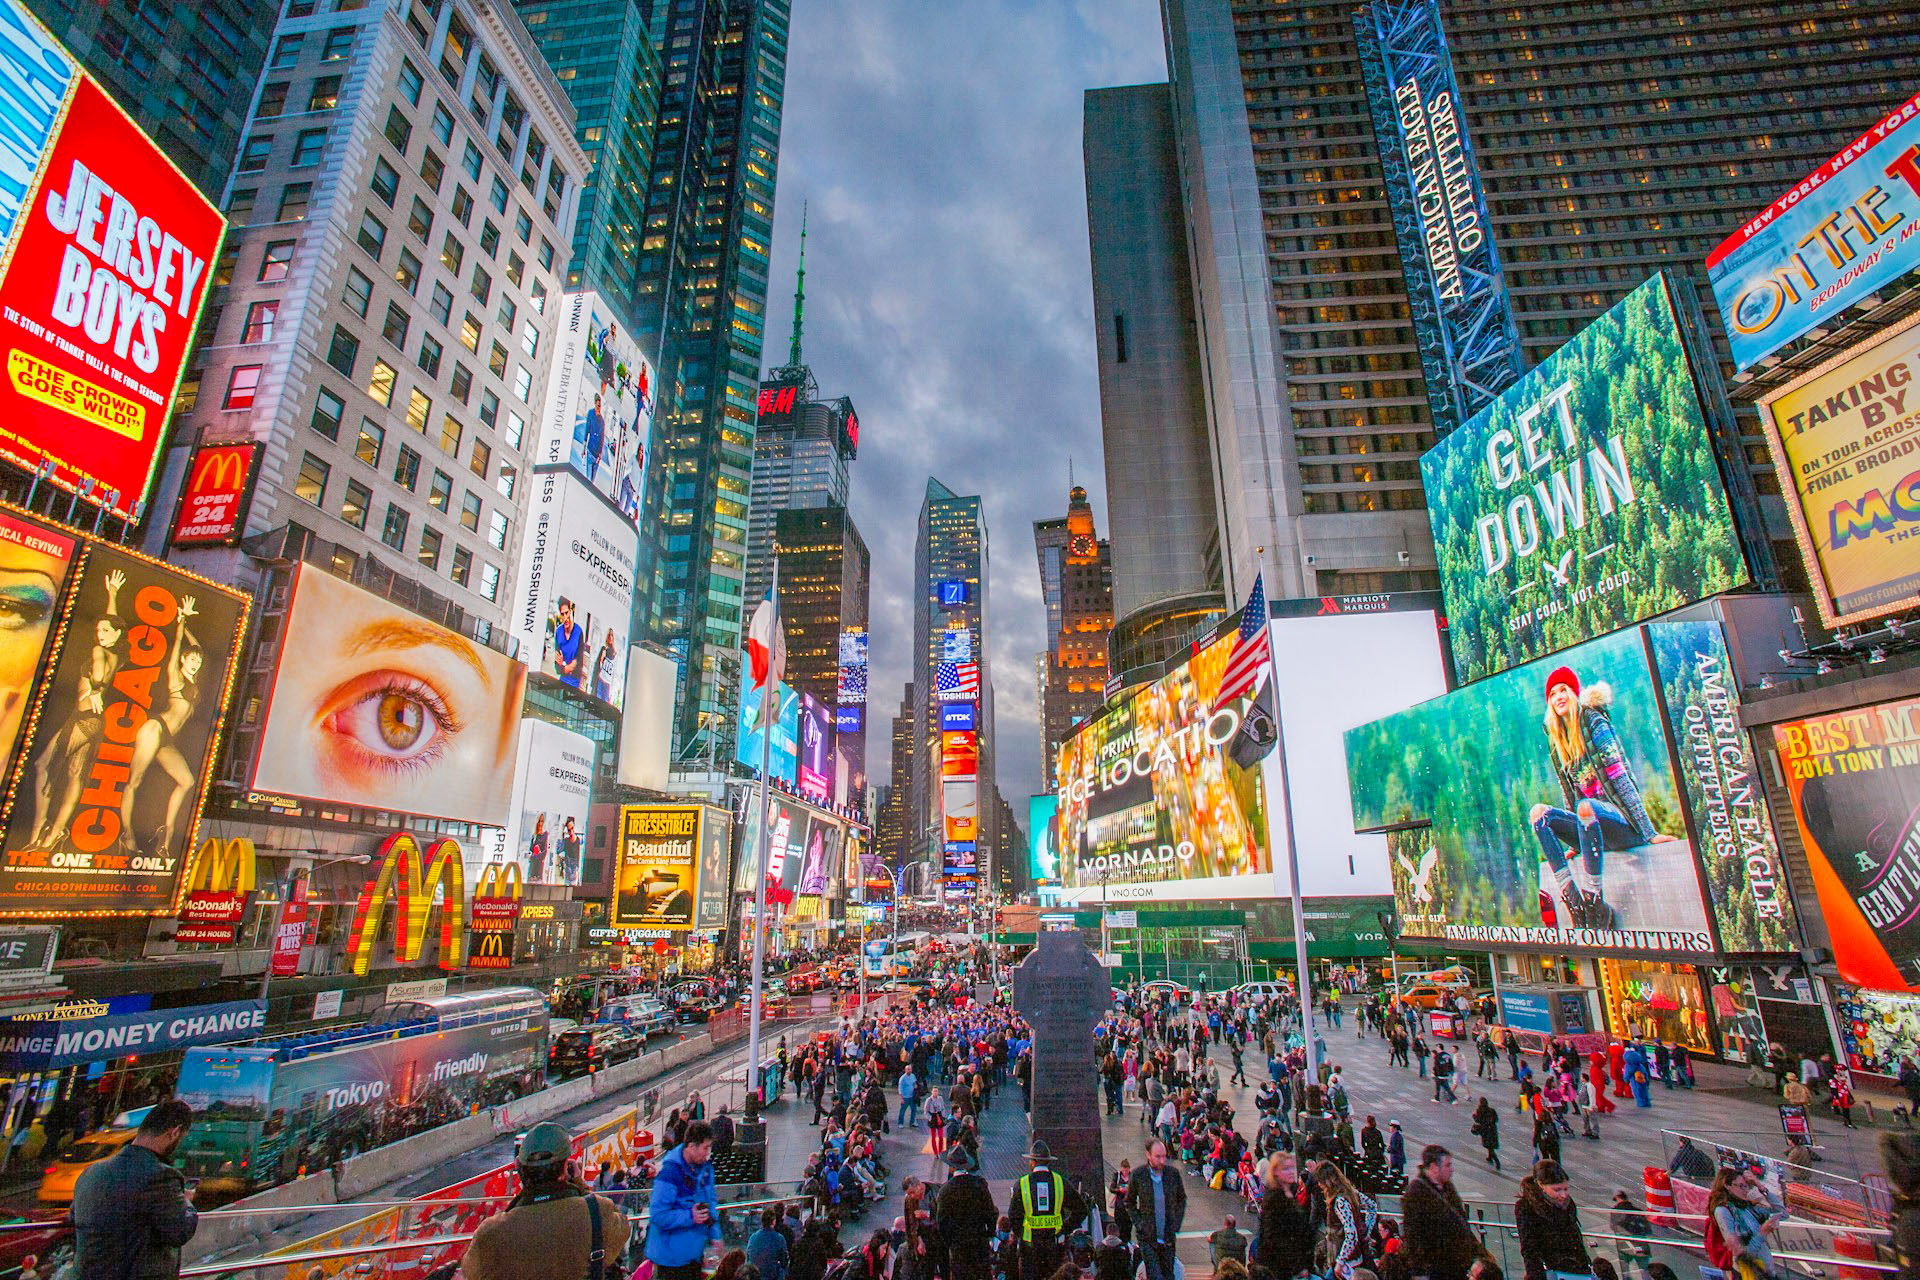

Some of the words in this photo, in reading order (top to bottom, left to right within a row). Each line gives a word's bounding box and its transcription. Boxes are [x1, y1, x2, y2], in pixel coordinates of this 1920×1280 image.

[1396, 77, 1430, 154] EAGLE
[1428, 92, 1483, 252] OUTFITTERS
[1744, 210, 1774, 238] NEW
[1778, 175, 1827, 209] YORK,
[1831, 137, 1869, 171] NEW
[46, 159, 205, 318] JERSEY
[1413, 157, 1464, 300] AMERICAN
[1731, 253, 1820, 334] ON
[1797, 185, 1906, 270] THE
[1810, 238, 1897, 312] BROADWAY'S
[51, 244, 166, 373] BOYS
[4, 306, 20, 324] THE
[20, 316, 44, 338] STORY
[45, 330, 55, 344] OF
[56, 336, 85, 361] FRANKIE
[86, 353, 103, 371] VALLI
[104, 364, 109, 375] &
[111, 368, 123, 382] THE
[123, 374, 139, 392] FOUR
[139, 383, 164, 406] SEASONS
[18, 372, 76, 404] GOES
[72, 379, 138, 417] CROWD
[1787, 362, 1912, 435] TAKING
[1860, 388, 1907, 429] BY
[1487, 380, 1575, 490] GET
[1802, 457, 1820, 475] ON
[1822, 440, 1861, 466] TOUR
[1806, 469, 1853, 495] FINAL
[192, 505, 227, 523] 24
[193, 494, 235, 505] OPEN
[1476, 435, 1635, 576] DOWN
[180, 524, 231, 536] HOURS
[24, 536, 63, 558] REVIVAL
[523, 512, 550, 633] @EXPRESSRUNWAY
[1343, 594, 1391, 604] MARRIOTT
[1344, 603, 1387, 611] MARQUIS
[1510, 614, 1533, 631] STAY
[1536, 601, 1568, 621] COOL.
[1572, 585, 1596, 605] NOT
[1598, 571, 1636, 595] COLD.
[938, 692, 977, 701] TOSHIBA
[71, 585, 178, 852] CHICAGO
[952, 713, 971, 721] TDK
[1101, 726, 1145, 760] PRIME
[1783, 712, 1871, 759] BEST
[1792, 757, 1834, 780] 2014
[1835, 748, 1885, 773] TONY
[1685, 704, 1737, 858] OUTFITTERS
[1695, 651, 1755, 807] AMERICAN
[1736, 815, 1784, 920] EAGLE
[627, 819, 696, 835] IRRESISTIBLE!
[8, 850, 49, 866] THE
[51, 853, 93, 868] ONE
[94, 855, 129, 869] THE
[131, 856, 176, 871] ONLY
[627, 839, 692, 857] Beautiful
[655, 858, 669, 866] King
[669, 857, 691, 865] Musical
[1082, 841, 1195, 873] VORNADO
[1854, 850, 1880, 873] A
[1135, 865, 1175, 876] TRUST
[15, 882, 157, 893] CHICAGOTHEMUSICAL.COM
[1111, 888, 1154, 897] VNO.COM
[474, 902, 518, 911] McDonald's
[207, 930, 231, 938] HOURS
[278, 921, 306, 937] JERSEY
[280, 936, 301, 950] BOYS
[589, 929, 618, 938] GIFTS
[625, 929, 672, 938] LUGGAGE
[1450, 926, 1520, 943] AMERICAN
[1526, 928, 1576, 945] EAGLE
[1582, 928, 1712, 951] OUTFITTERS
[53, 1005, 110, 1020] EXCHANGE
[54, 1022, 163, 1056] MONEY
[170, 1009, 267, 1038] CHANGE
[491, 1023, 520, 1035] UNITED
[434, 1052, 488, 1083] friendly
[326, 1080, 384, 1111] Tokyo
